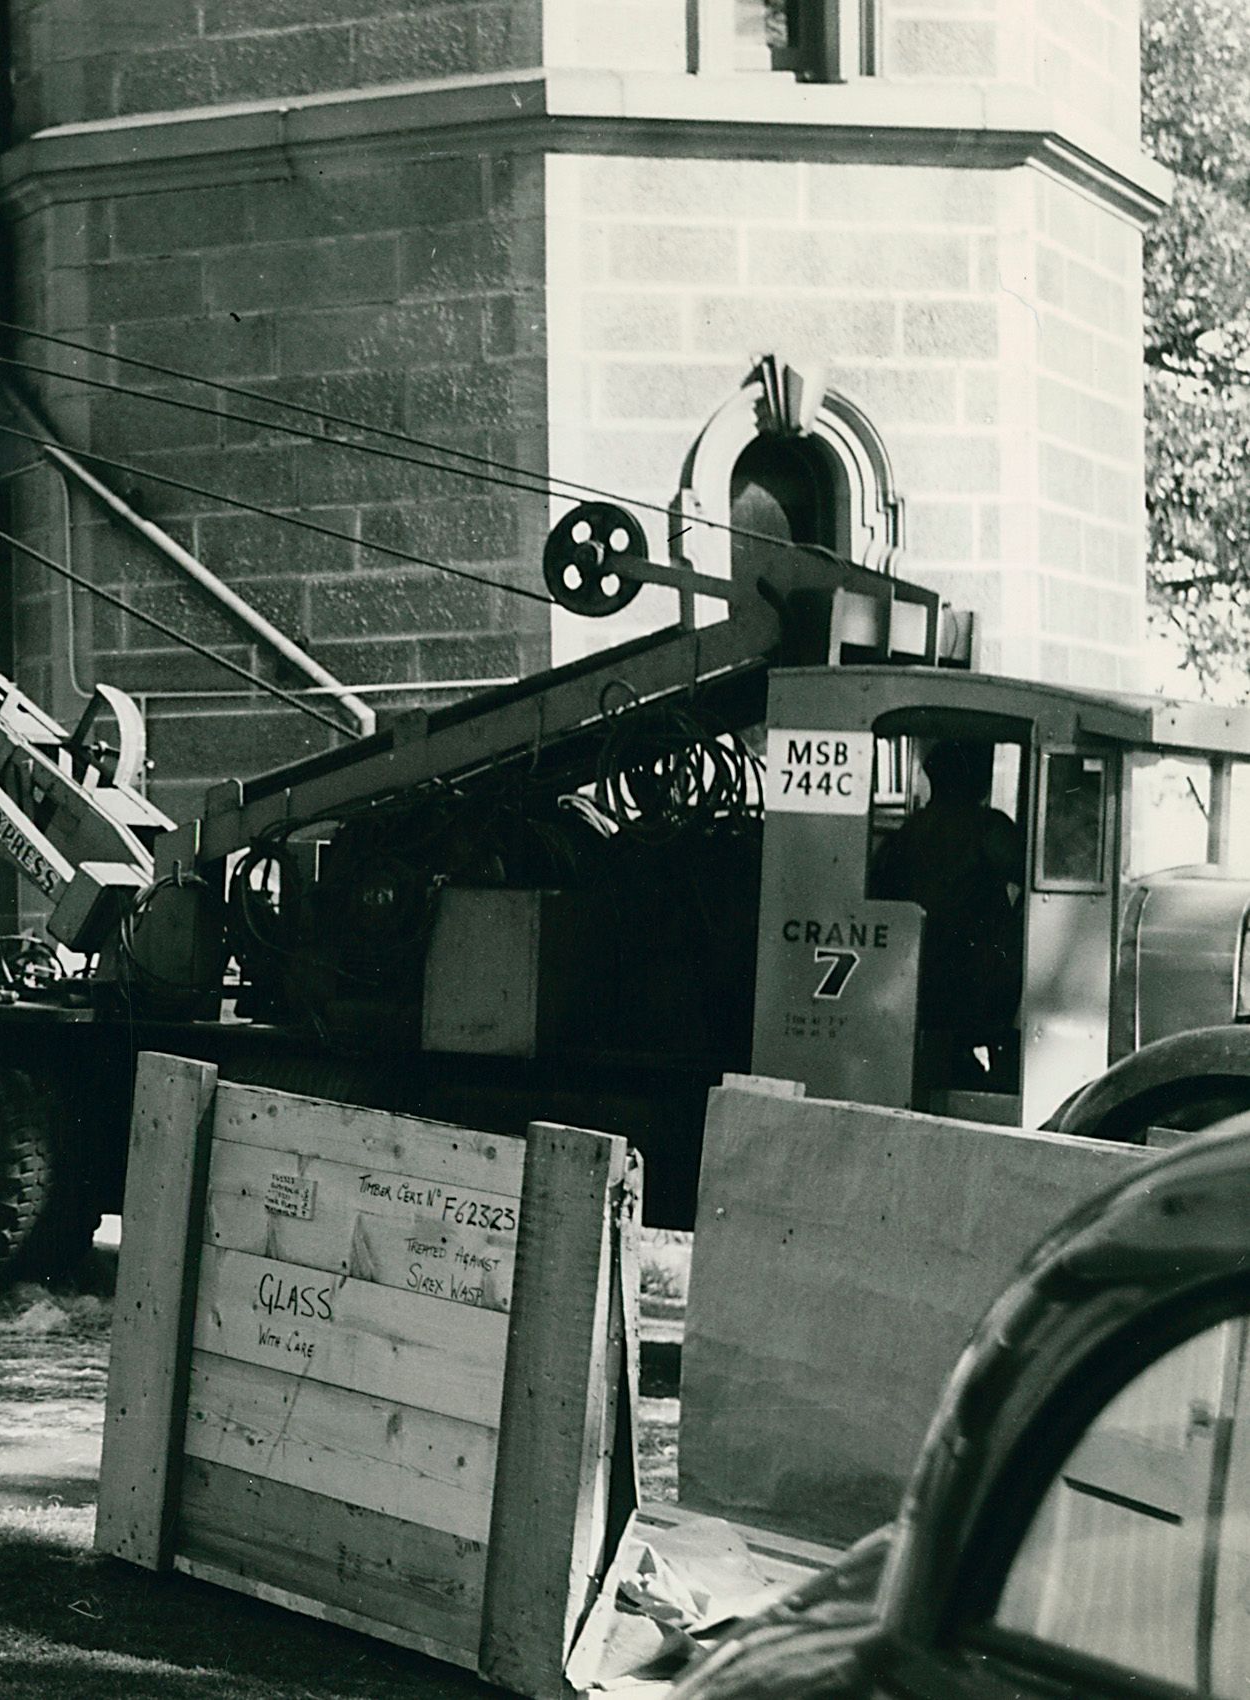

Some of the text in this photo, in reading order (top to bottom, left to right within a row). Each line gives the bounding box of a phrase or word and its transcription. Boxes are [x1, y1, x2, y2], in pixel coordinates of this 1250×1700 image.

[787, 740, 849, 765] MSB
[780, 771, 853, 796] 744C
[782, 919, 889, 949] CRANE
[813, 947, 861, 999] 7
[358, 1174, 392, 1201] TIMBER
[442, 1197, 516, 1231] F62323
[259, 1273, 332, 1320] GLASS
[406, 1262, 484, 1304] SIREX WASP
[286, 1330, 315, 1358] CARE
